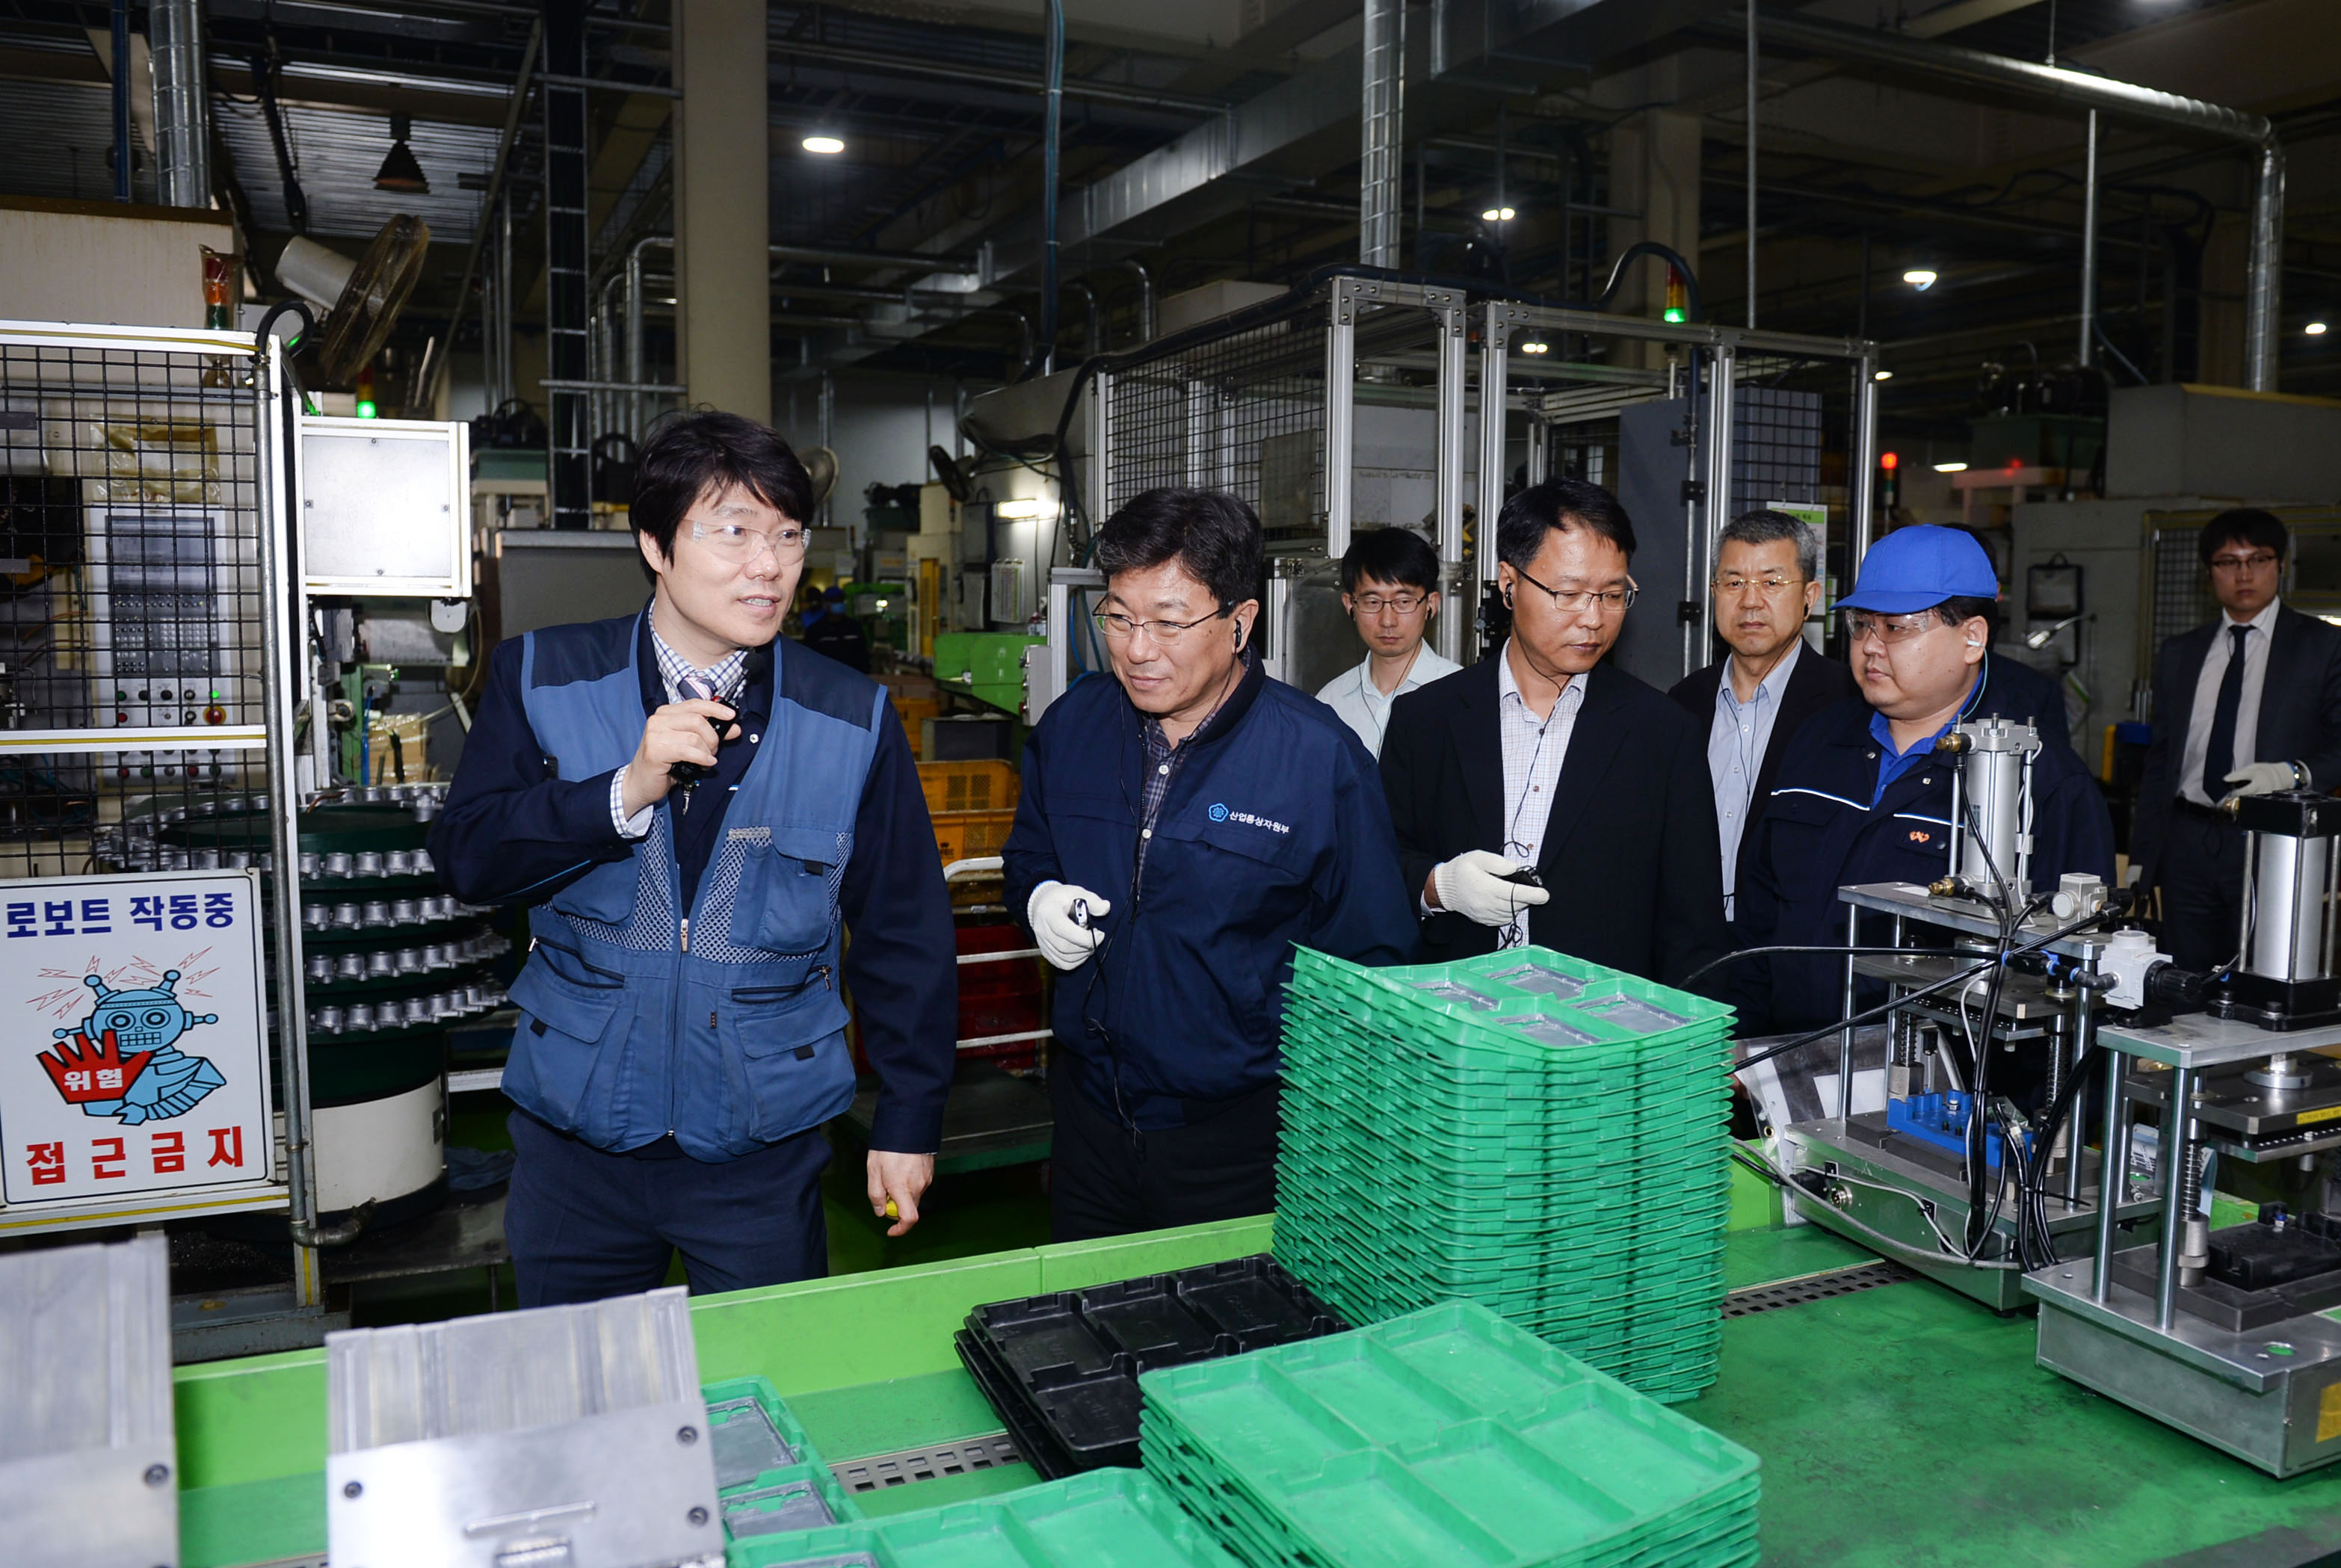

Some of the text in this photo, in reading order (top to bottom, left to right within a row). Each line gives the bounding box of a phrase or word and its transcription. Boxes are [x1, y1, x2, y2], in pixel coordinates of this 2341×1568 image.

[1230, 812, 1289, 833] 산업통상자원부
[7, 892, 234, 938] 로보트 작동중
[64, 1067, 124, 1093] 위험
[26, 1126, 244, 1186] 접근금지
